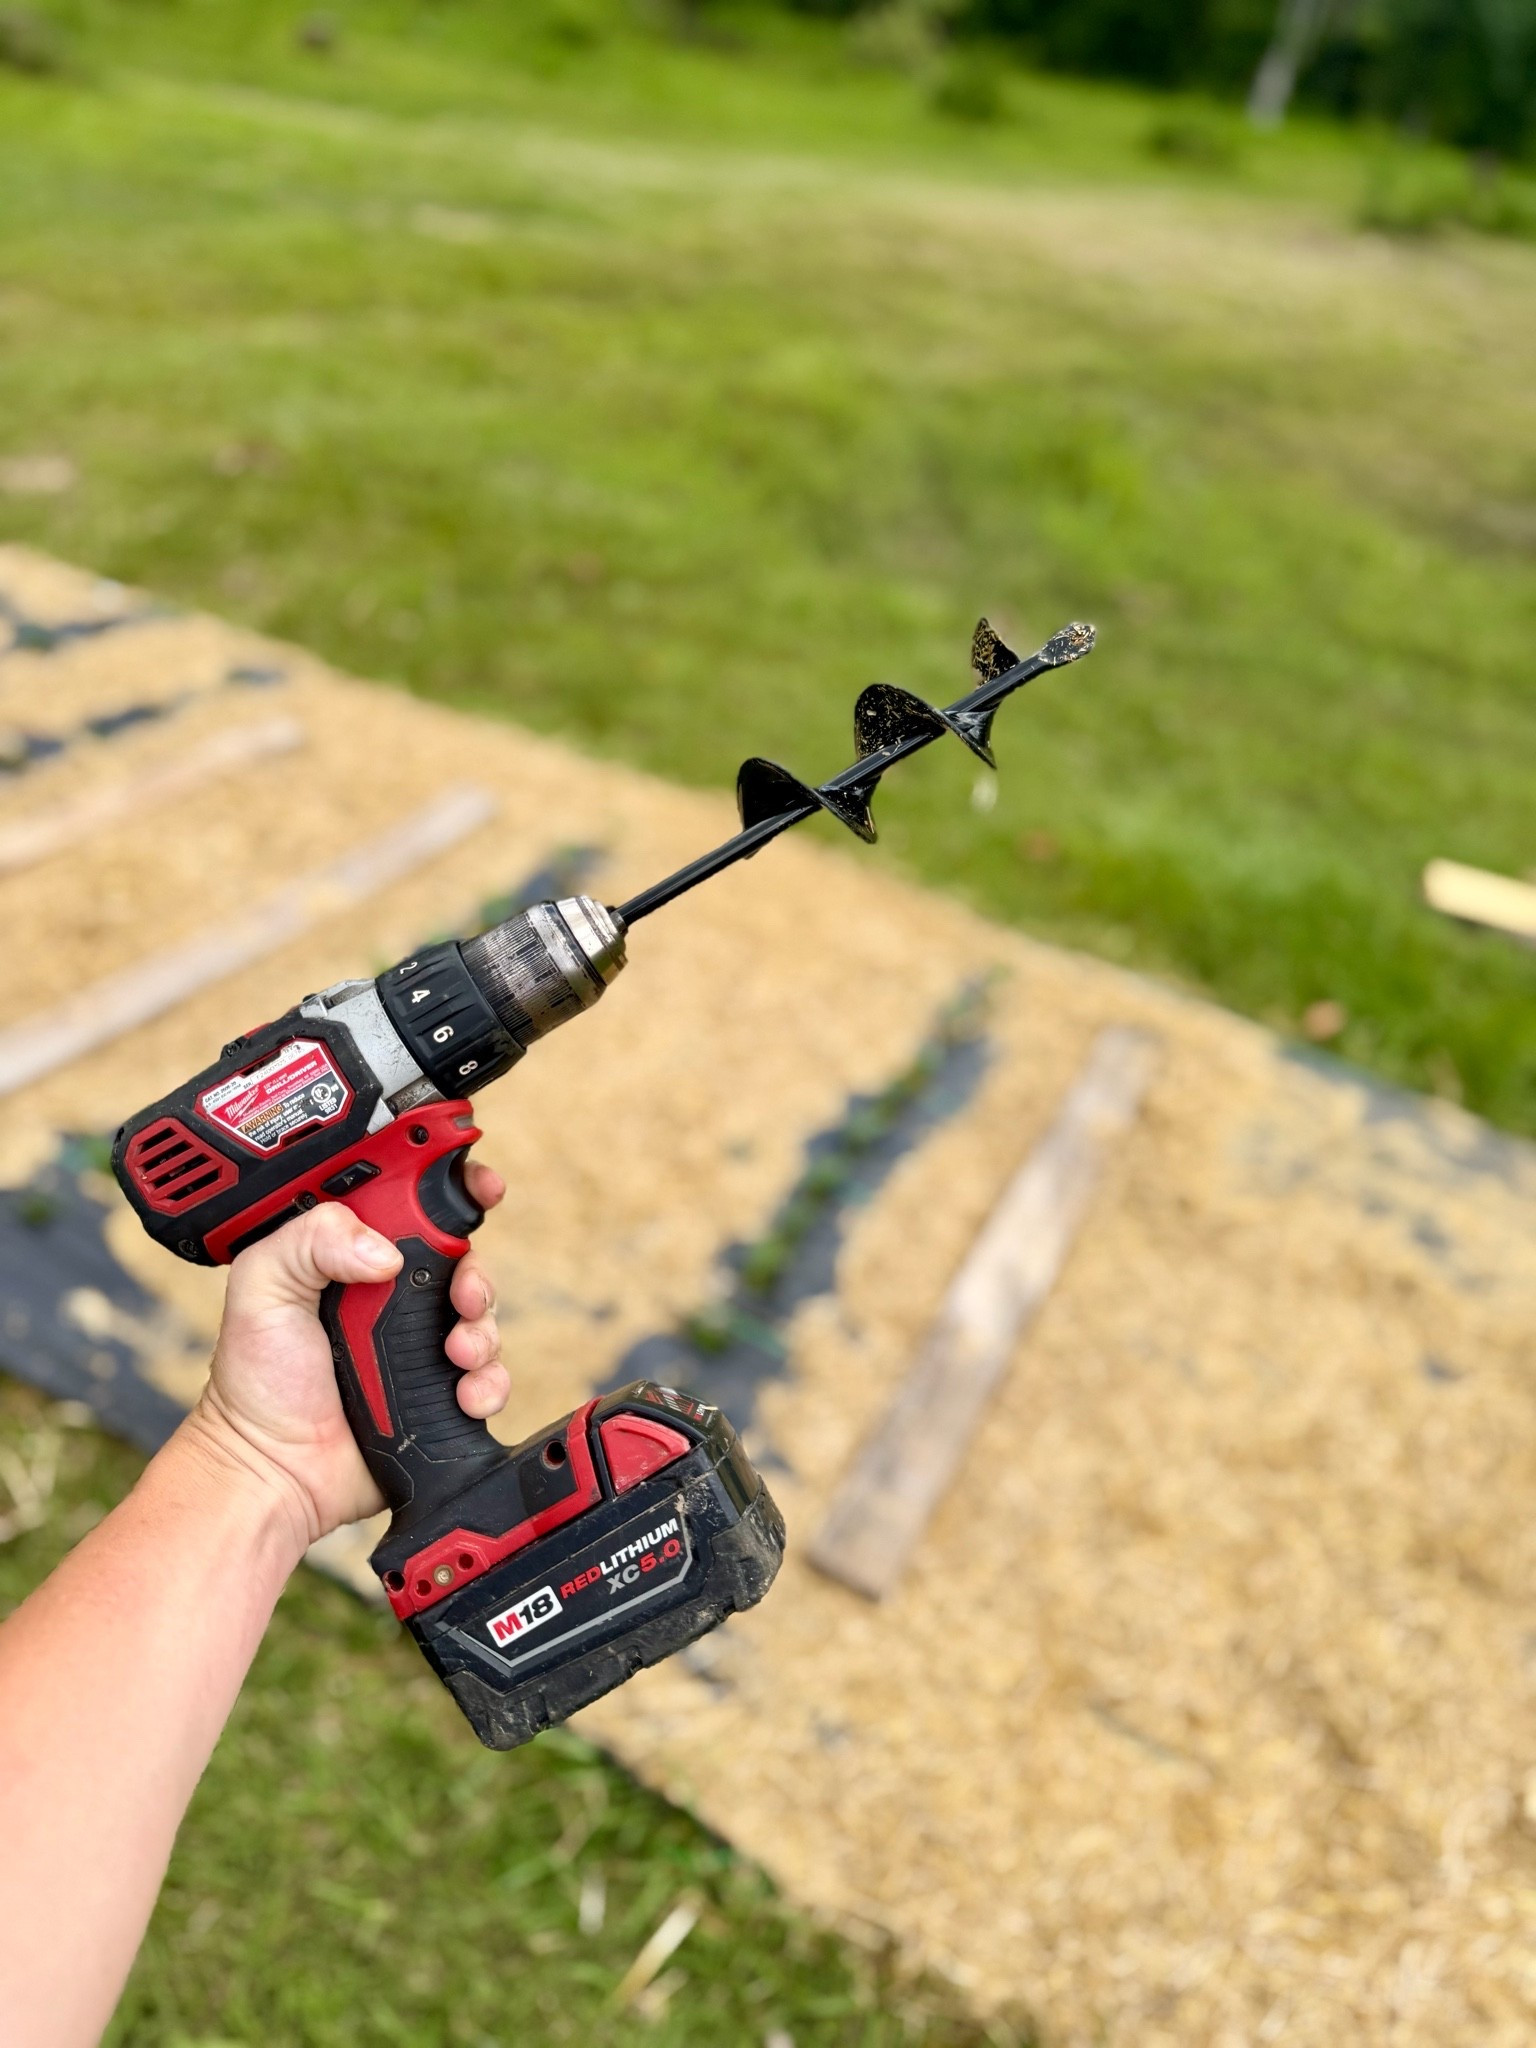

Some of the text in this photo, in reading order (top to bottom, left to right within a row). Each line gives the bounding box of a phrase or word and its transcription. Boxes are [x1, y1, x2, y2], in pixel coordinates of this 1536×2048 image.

[400, 961, 418, 975] 2
[411, 989, 431, 1003] 4
[433, 1025, 454, 1043] 6
[265, 1060, 317, 1094] DRILL/DRIVER
[458, 1060, 478, 1076] 8
[224, 1086, 259, 1119] Milwaukee
[318, 1096, 337, 1111] LISTED
[247, 1104, 282, 1128] WARNING
[255, 1124, 264, 1132] risk
[259, 1133, 271, 1144] Hold
[560, 1517, 679, 1599] REDLITHIUM
[606, 1538, 681, 1594] XC5.0
[492, 1592, 554, 1641] M18
